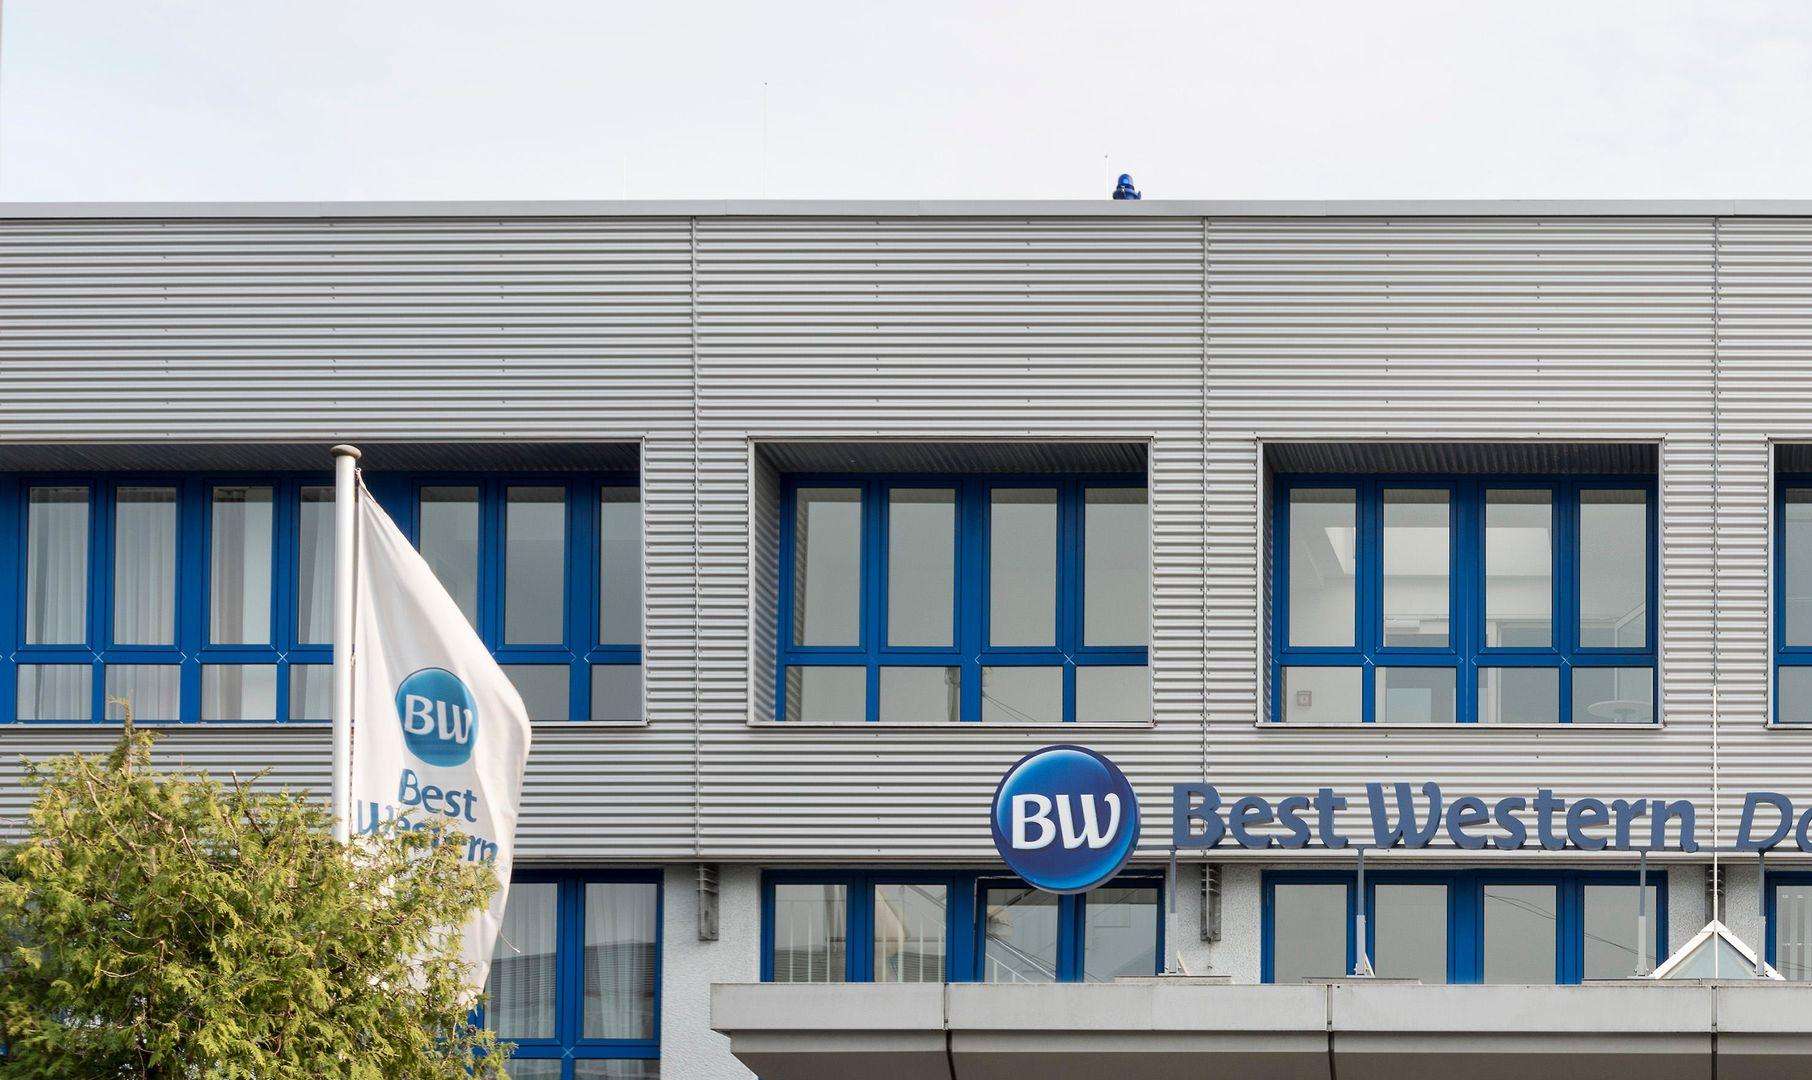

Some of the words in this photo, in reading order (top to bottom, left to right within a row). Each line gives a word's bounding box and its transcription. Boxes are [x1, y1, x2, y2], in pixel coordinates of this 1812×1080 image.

[404, 693, 473, 744] BW
[398, 768, 477, 823] Best
[1011, 792, 1121, 851] BW
[1172, 783, 1348, 850] Best
[1366, 781, 1699, 853] Western
